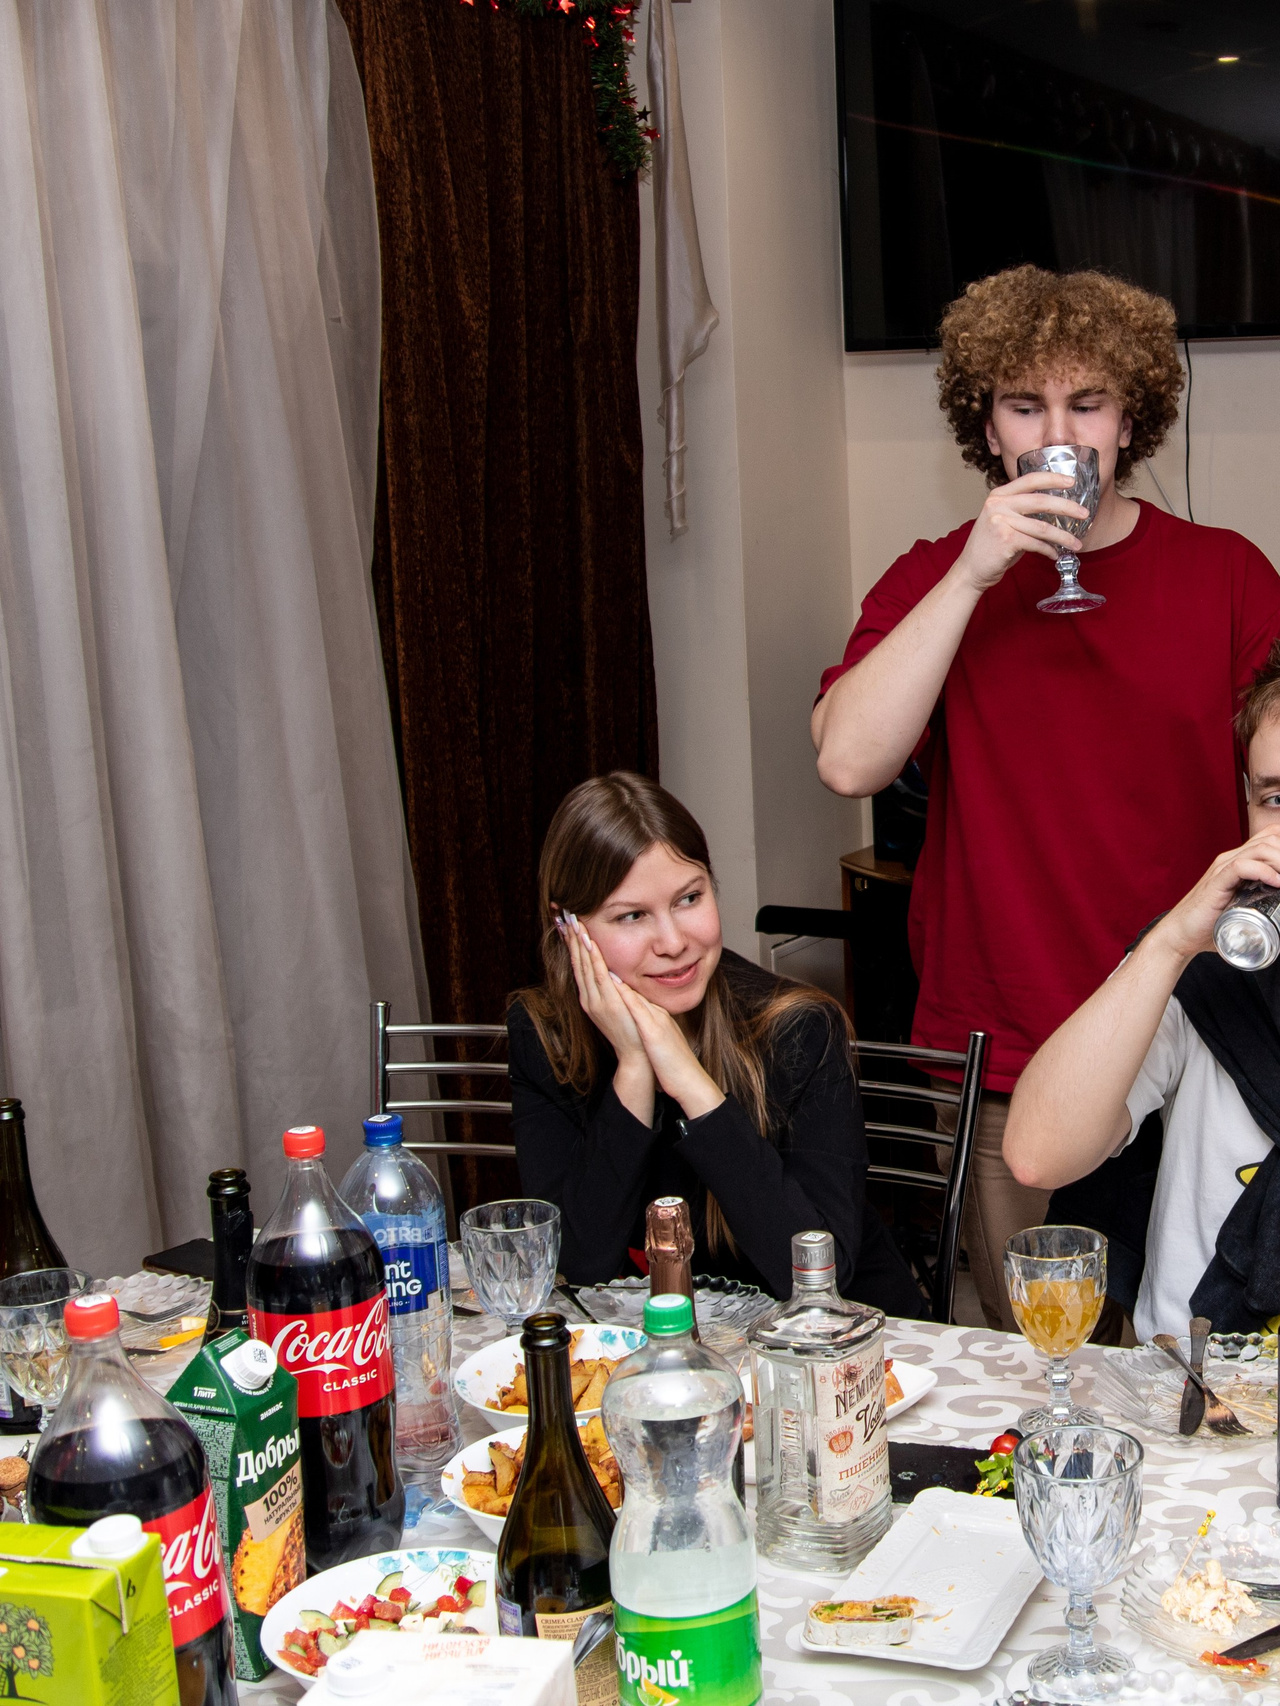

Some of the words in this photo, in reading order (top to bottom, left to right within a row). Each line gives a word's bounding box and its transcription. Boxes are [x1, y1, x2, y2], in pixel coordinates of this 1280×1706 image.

[322, 1369, 378, 1392] CLASSIC
[259, 1401, 284, 1421] ананас
[262, 1470, 298, 1512] 100%
[274, 1499, 298, 1524] ФРУКТЫ
[615, 1636, 690, 1688] брый
